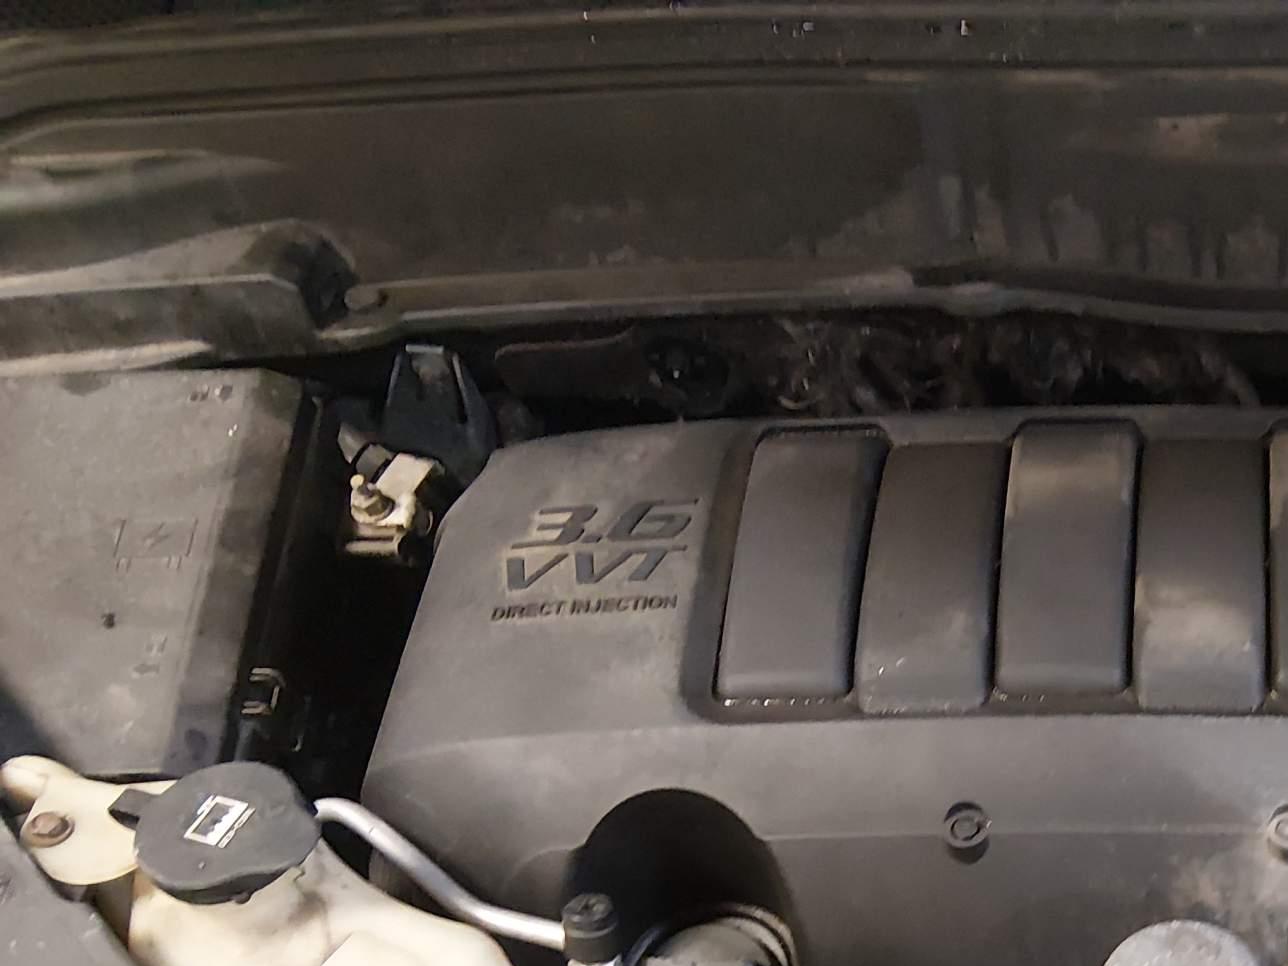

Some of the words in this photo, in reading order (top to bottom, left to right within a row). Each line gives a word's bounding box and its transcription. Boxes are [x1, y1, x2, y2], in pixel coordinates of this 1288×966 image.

[509, 497, 700, 550] 3.6
[505, 544, 688, 592] VVT
[490, 602, 564, 622] DIRECT
[569, 594, 679, 616] INJECTION
